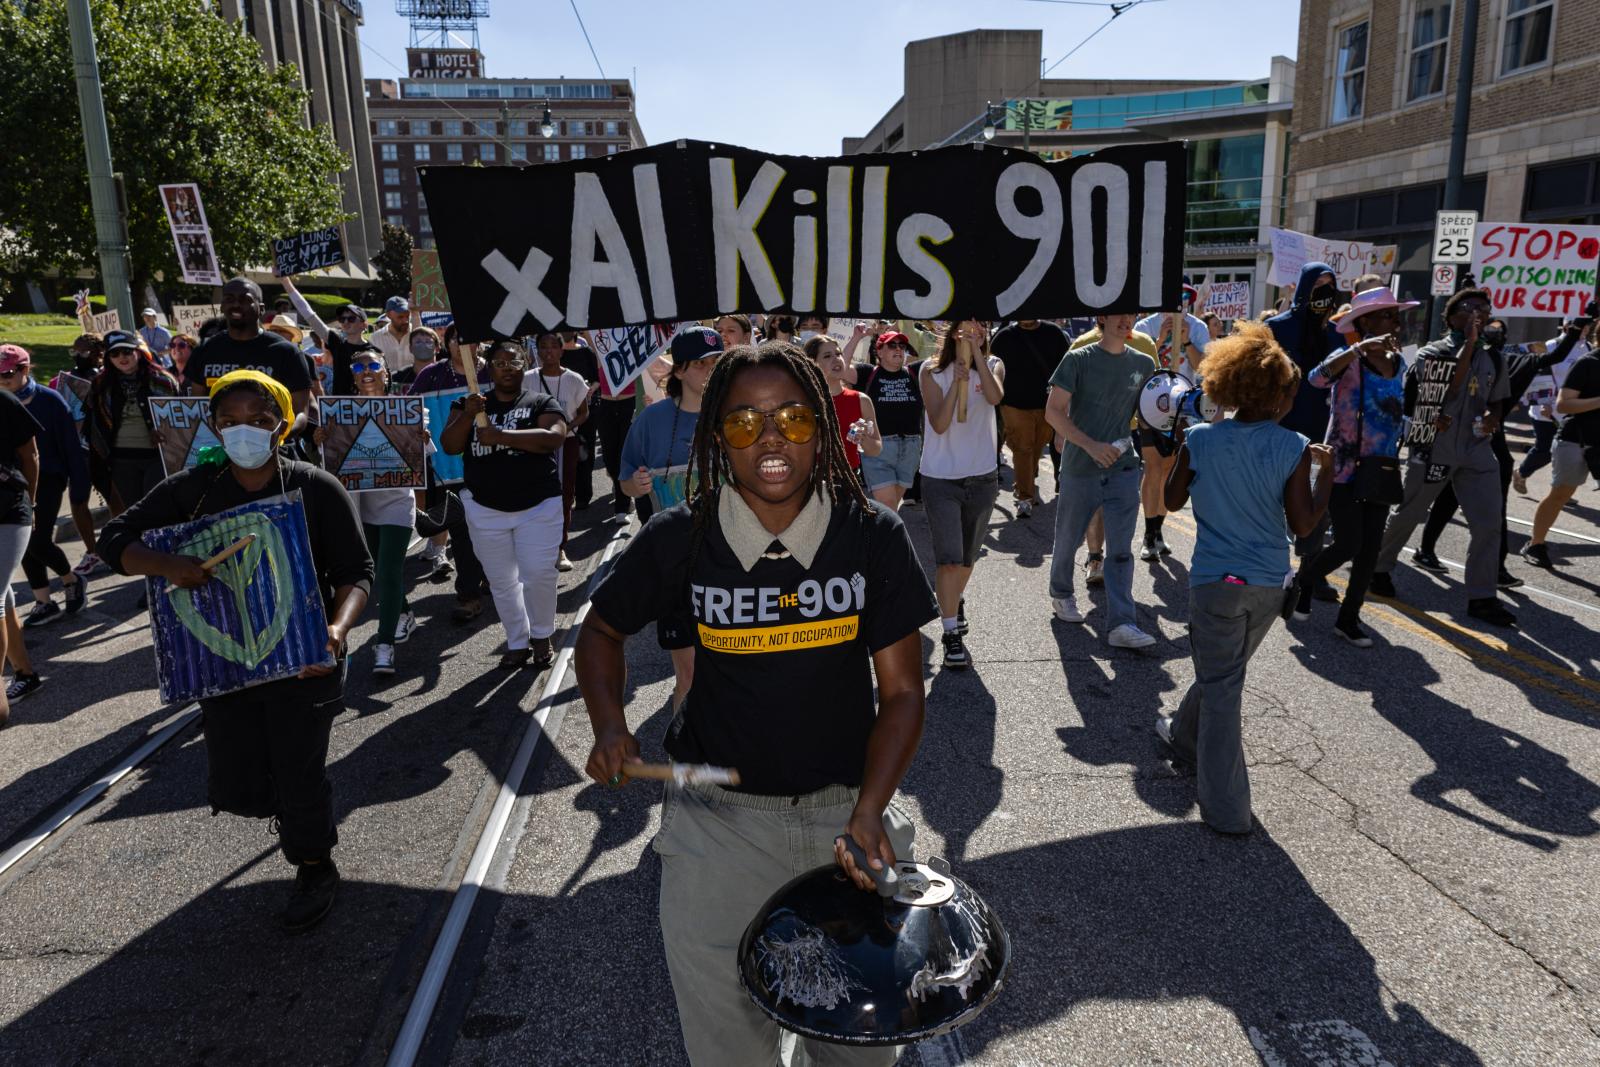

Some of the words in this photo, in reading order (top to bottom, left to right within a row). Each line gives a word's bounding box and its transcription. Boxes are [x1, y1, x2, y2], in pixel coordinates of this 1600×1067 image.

[436, 54, 474, 67] HOTEL
[1440, 217, 1474, 226] SPEED
[275, 237, 298, 252] Our
[301, 226, 339, 245] LUNGS
[1443, 228, 1468, 236] LIMIT
[277, 251, 296, 264] are
[300, 242, 330, 258] NOT
[480, 163, 678, 338] xAI
[709, 157, 954, 319] Kills
[995, 161, 1167, 318] 901
[1438, 238, 1470, 256] 25
[1481, 226, 1578, 264] STOP
[300, 252, 342, 271] SALE
[1480, 265, 1596, 286] POISONING
[1203, 292, 1240, 306] ILENT
[1531, 289, 1591, 316] CITY
[320, 398, 422, 426] MEMPHIS
[503, 407, 530, 424] TECH
[1408, 424, 1437, 444] POOR
[374, 471, 424, 488] MUSK
[691, 584, 780, 624] FREE
[778, 594, 798, 608] THE
[702, 632, 766, 648] OPPORTUNITY,
[768, 632, 790, 646] NOT
[792, 623, 856, 644] OCCUPATION!
